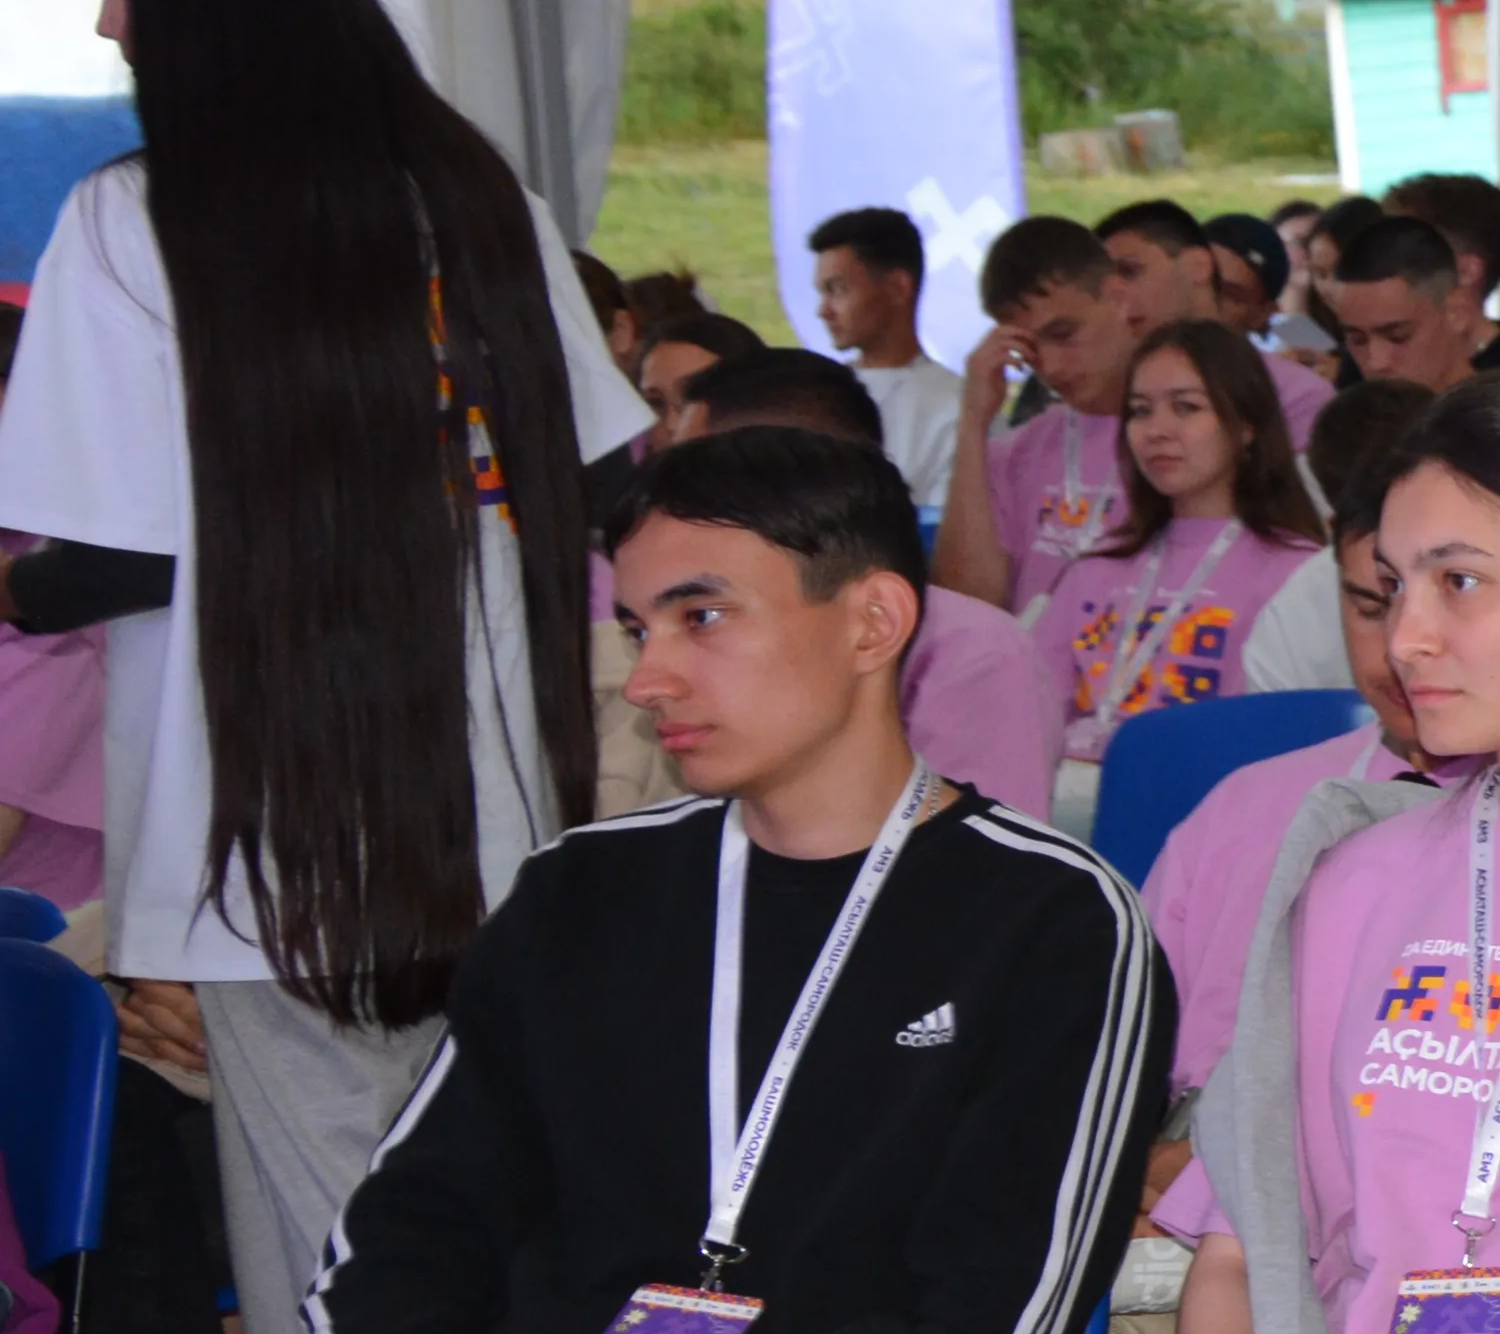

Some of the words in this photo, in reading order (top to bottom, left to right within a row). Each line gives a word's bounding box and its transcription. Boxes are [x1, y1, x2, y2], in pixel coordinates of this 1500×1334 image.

[872, 844, 894, 874] АМЗ
[786, 894, 867, 1052] АСЫЛТАШ-САМОРОДОК
[731, 1075, 784, 1193] БАШМОЛОДЁЖЬ
[1477, 1151, 1495, 1184] АМЗ
